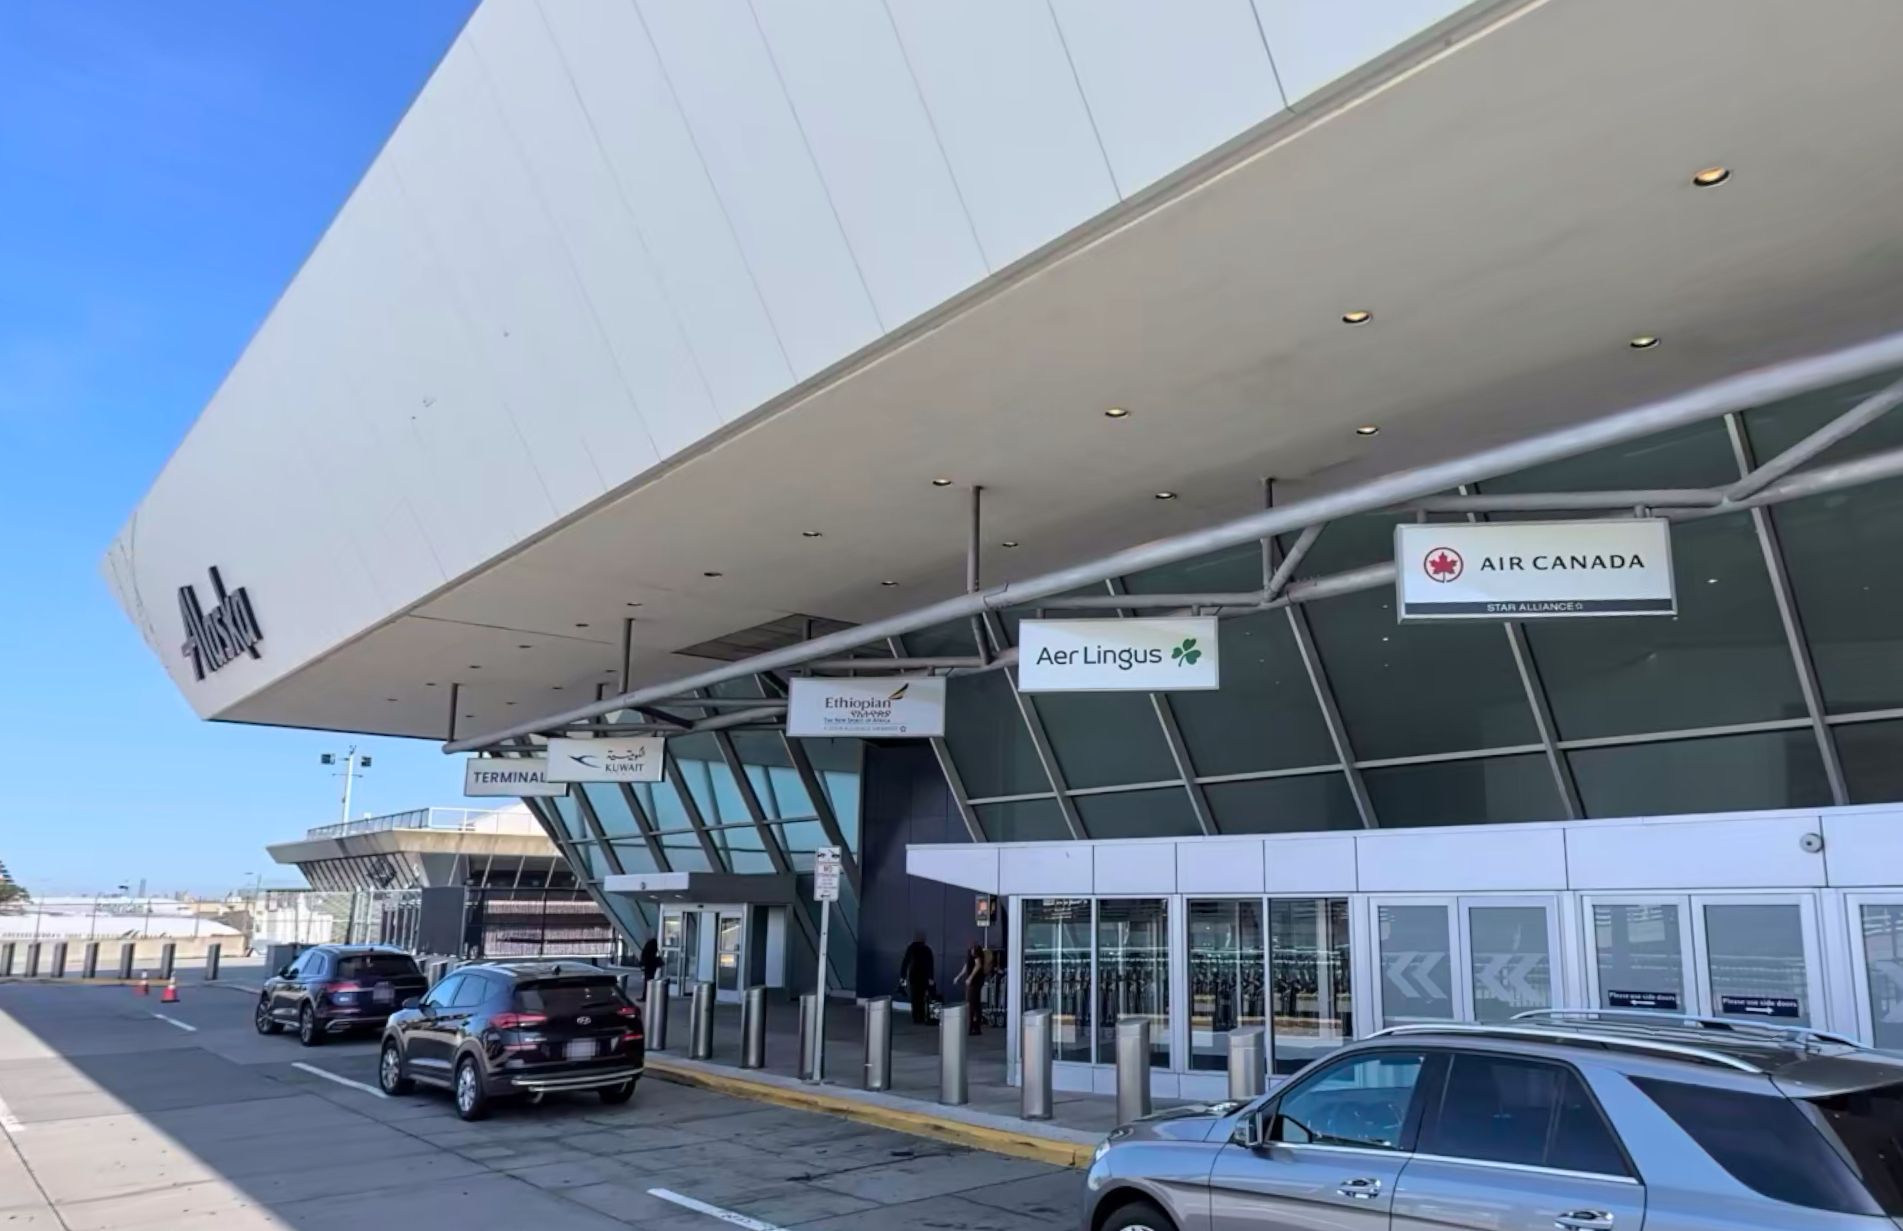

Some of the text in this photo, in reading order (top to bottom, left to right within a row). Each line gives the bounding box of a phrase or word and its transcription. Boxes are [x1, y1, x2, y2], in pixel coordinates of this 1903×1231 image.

[1480, 554, 1645, 571] AIR CANADA
[1486, 602, 1574, 612] STAR ALLIANCE
[1036, 645, 1163, 671] Aer Lingus
[825, 697, 891, 710] Ethiopian
[605, 763, 645, 772] KUWAIT
[473, 771, 547, 784] TERMINAL
[1722, 997, 1745, 1005] Please
